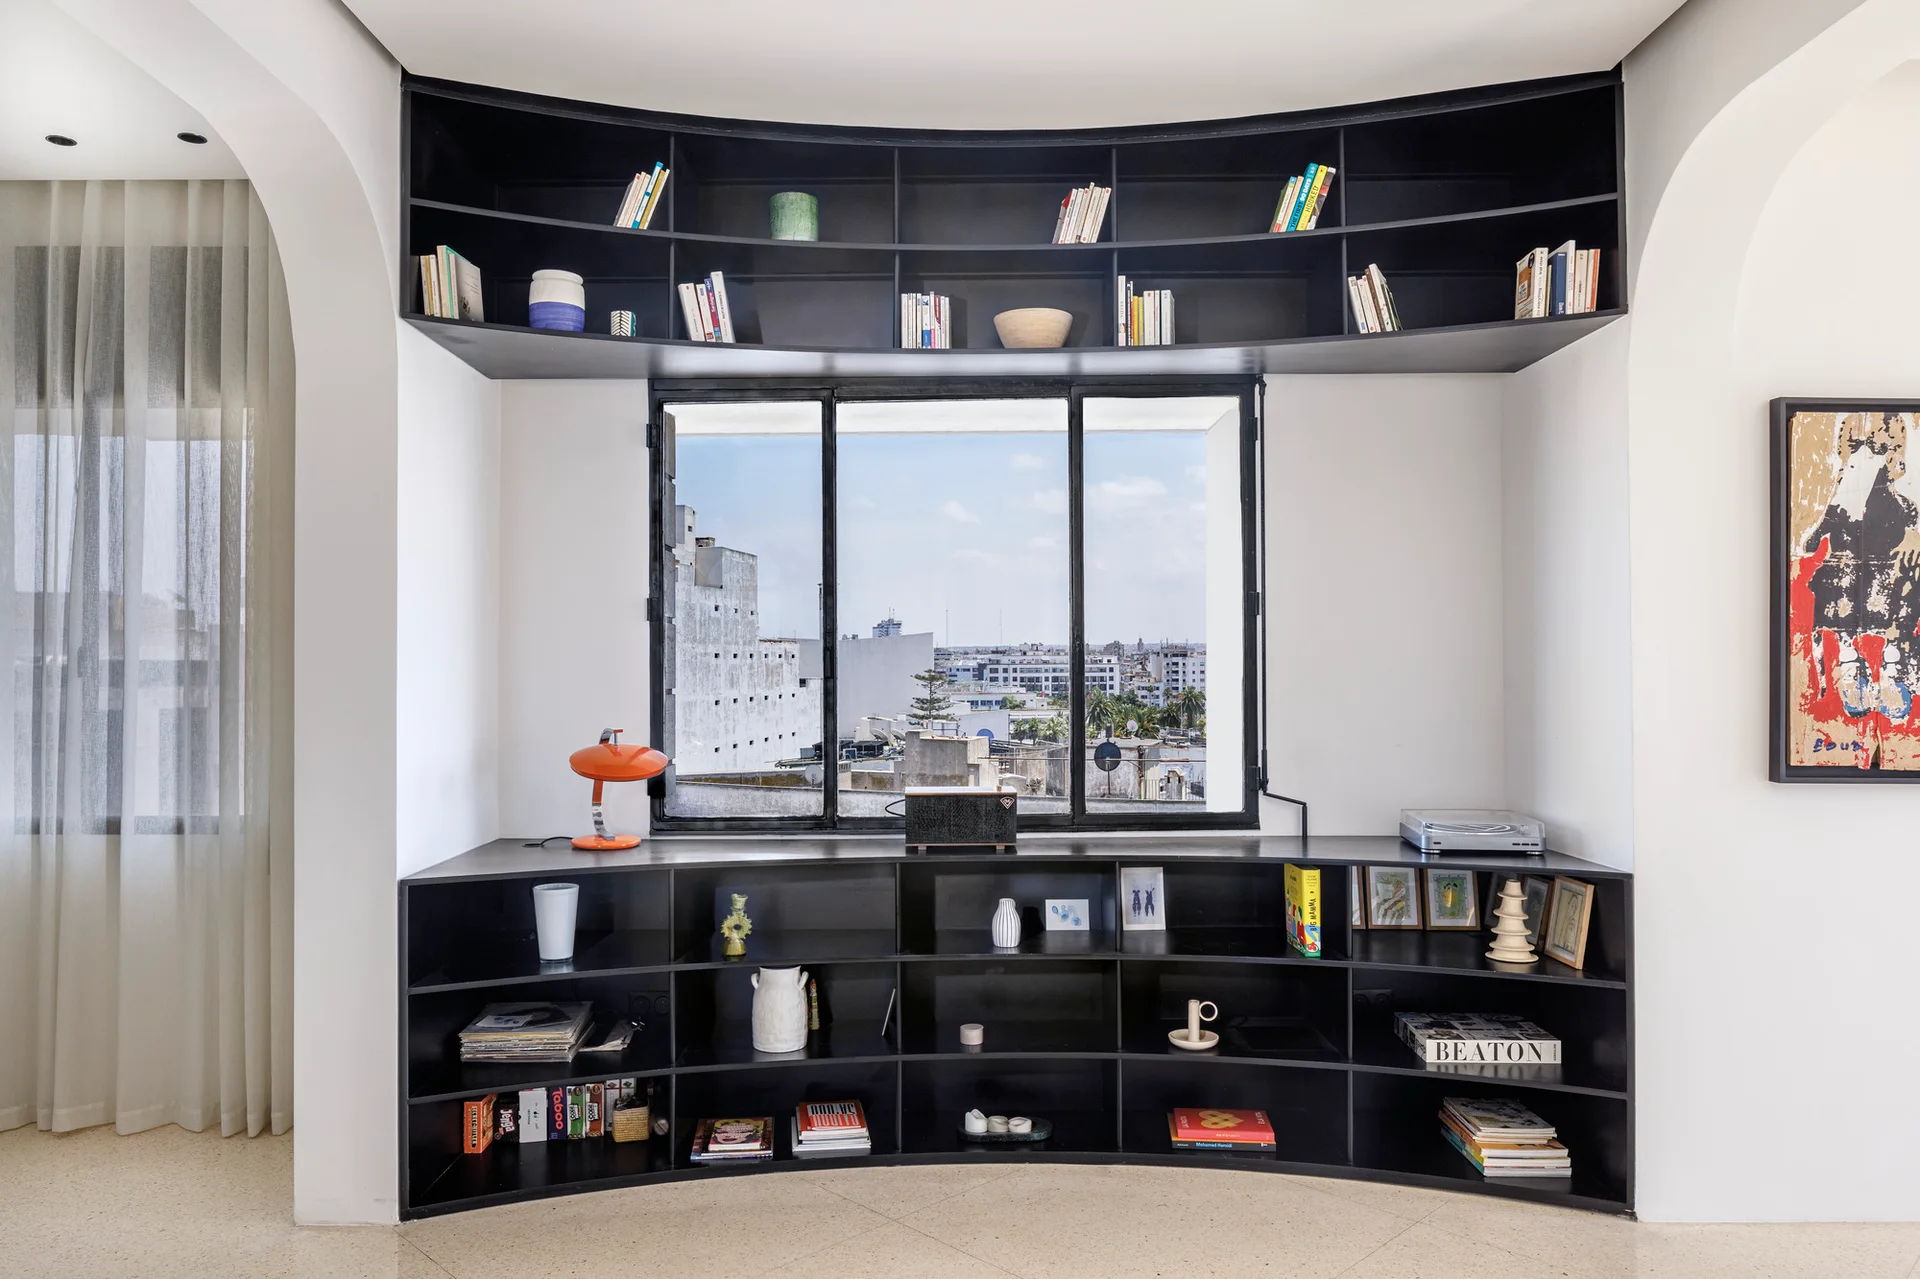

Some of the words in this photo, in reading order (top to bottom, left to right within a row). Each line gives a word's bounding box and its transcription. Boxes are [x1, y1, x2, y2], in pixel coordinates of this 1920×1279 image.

[1305, 185, 1319, 212] HOOKED
[1308, 898, 1317, 920] MAMMA
[1309, 921, 1318, 931] BIG
[1435, 1042, 1543, 1062] BEATON
[552, 1087, 564, 1130] Taboo
[500, 1109, 515, 1133] Jenga
